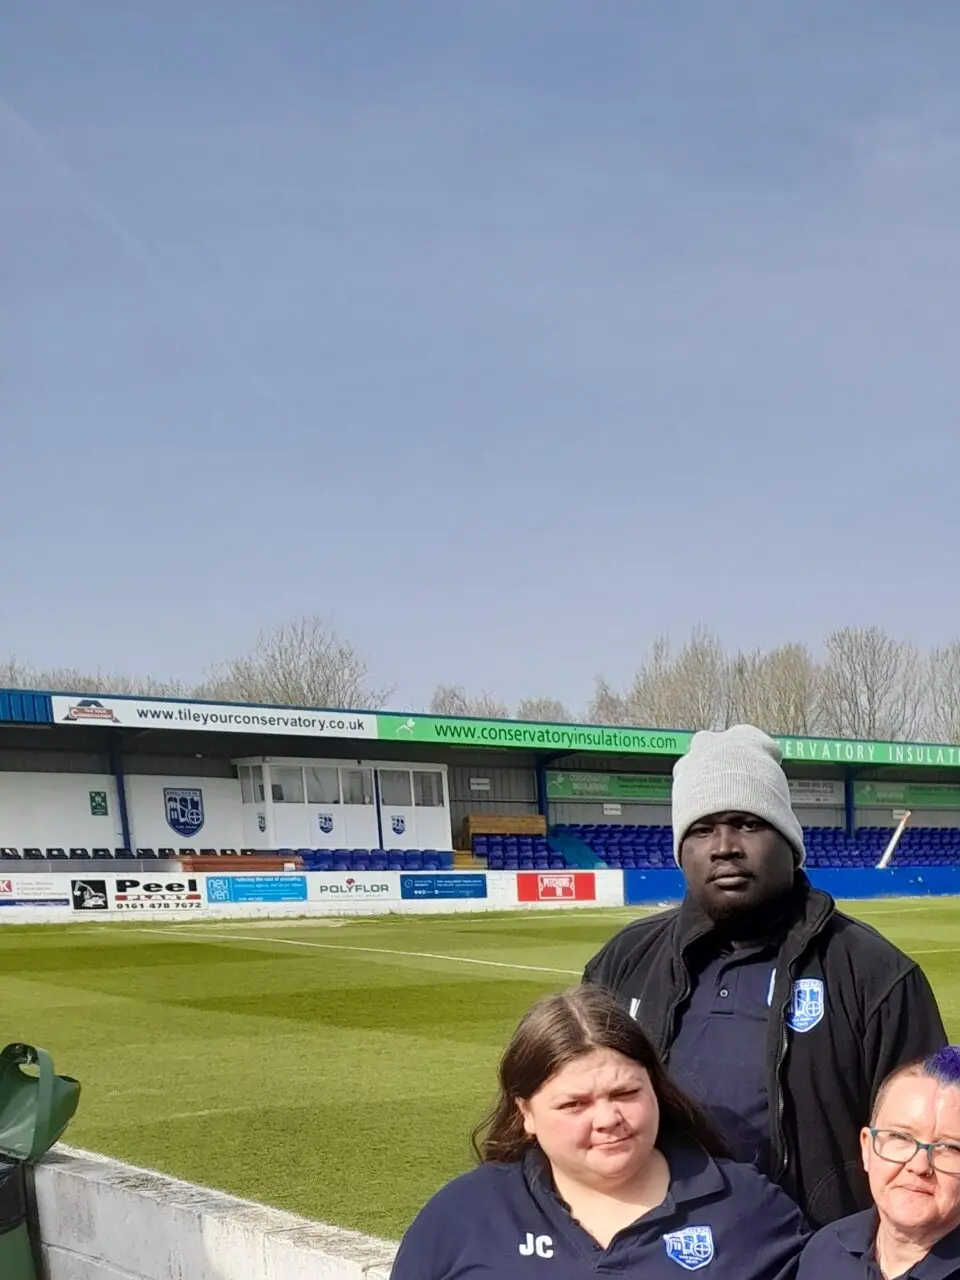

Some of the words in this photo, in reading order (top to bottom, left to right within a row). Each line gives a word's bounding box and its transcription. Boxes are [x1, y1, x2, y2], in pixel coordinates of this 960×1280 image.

[136, 707, 364, 731] www.tileyourconservatory.co.uk
[434, 723, 677, 749] www.conservatoryinsulations.com
[776, 741, 875, 761] ERVATORY
[116, 879, 198, 893] Peel
[208, 878, 228, 889] neu
[320, 884, 389, 893] POLYFLOR
[209, 890, 230, 900] ven
[518, 1232, 554, 1258] JC
